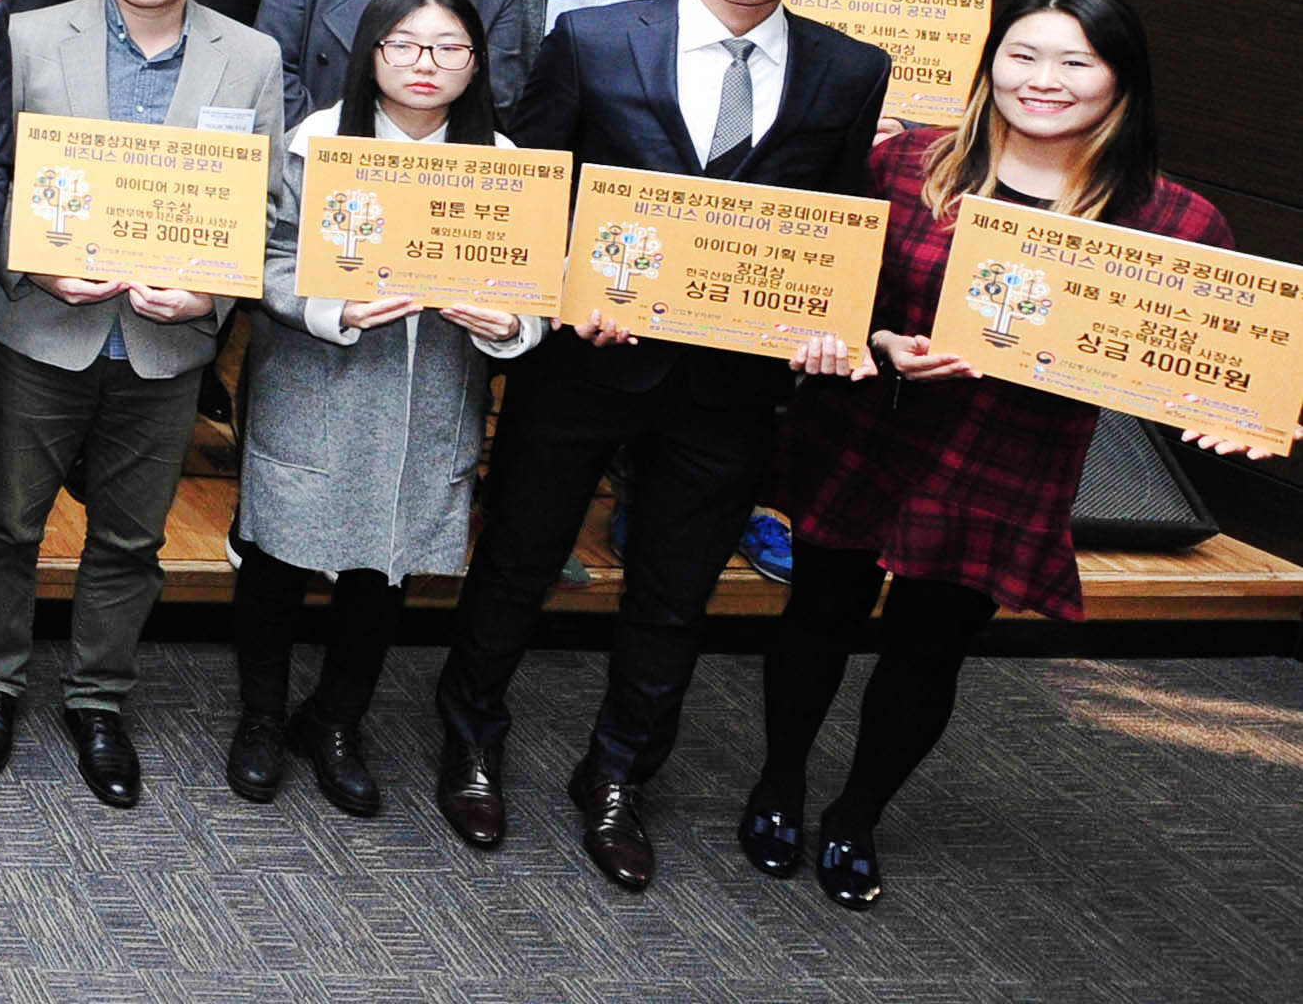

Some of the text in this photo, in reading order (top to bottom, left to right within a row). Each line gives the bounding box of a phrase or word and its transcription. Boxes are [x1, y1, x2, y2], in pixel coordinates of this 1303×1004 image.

[848, 0, 947, 20] 아이디어 공모전
[871, 26, 972, 44] 서비스 개발 부문
[28, 128, 263, 162] 제4회 산업통상자원부 공공데이터활용
[64, 146, 223, 173] 비즈니스 아이디어 공모전
[317, 150, 566, 180] 제4회 산업통상자원부 공공데이터활용
[355, 168, 523, 192] 비즈니스 아이디어 공모전
[591, 180, 881, 230] 제4회 산업통상자원부 공공데이터활용
[634, 202, 830, 239] 비즈니스 아이디어 공모전
[112, 220, 230, 248] 상금 300만원
[971, 212, 1164, 272] 제4회 산업통상자원부
[405, 240, 529, 266] 상금 100만원
[694, 237, 835, 268] 아이디어 기획 부문
[1021, 241, 1257, 308] 비즈니스 아이디어 공모전
[685, 280, 830, 318] 상금 100만원
[1063, 280, 1291, 346] 제품 및 서비스 개발 부문
[1076, 332, 1251, 394] 상금 400만원
